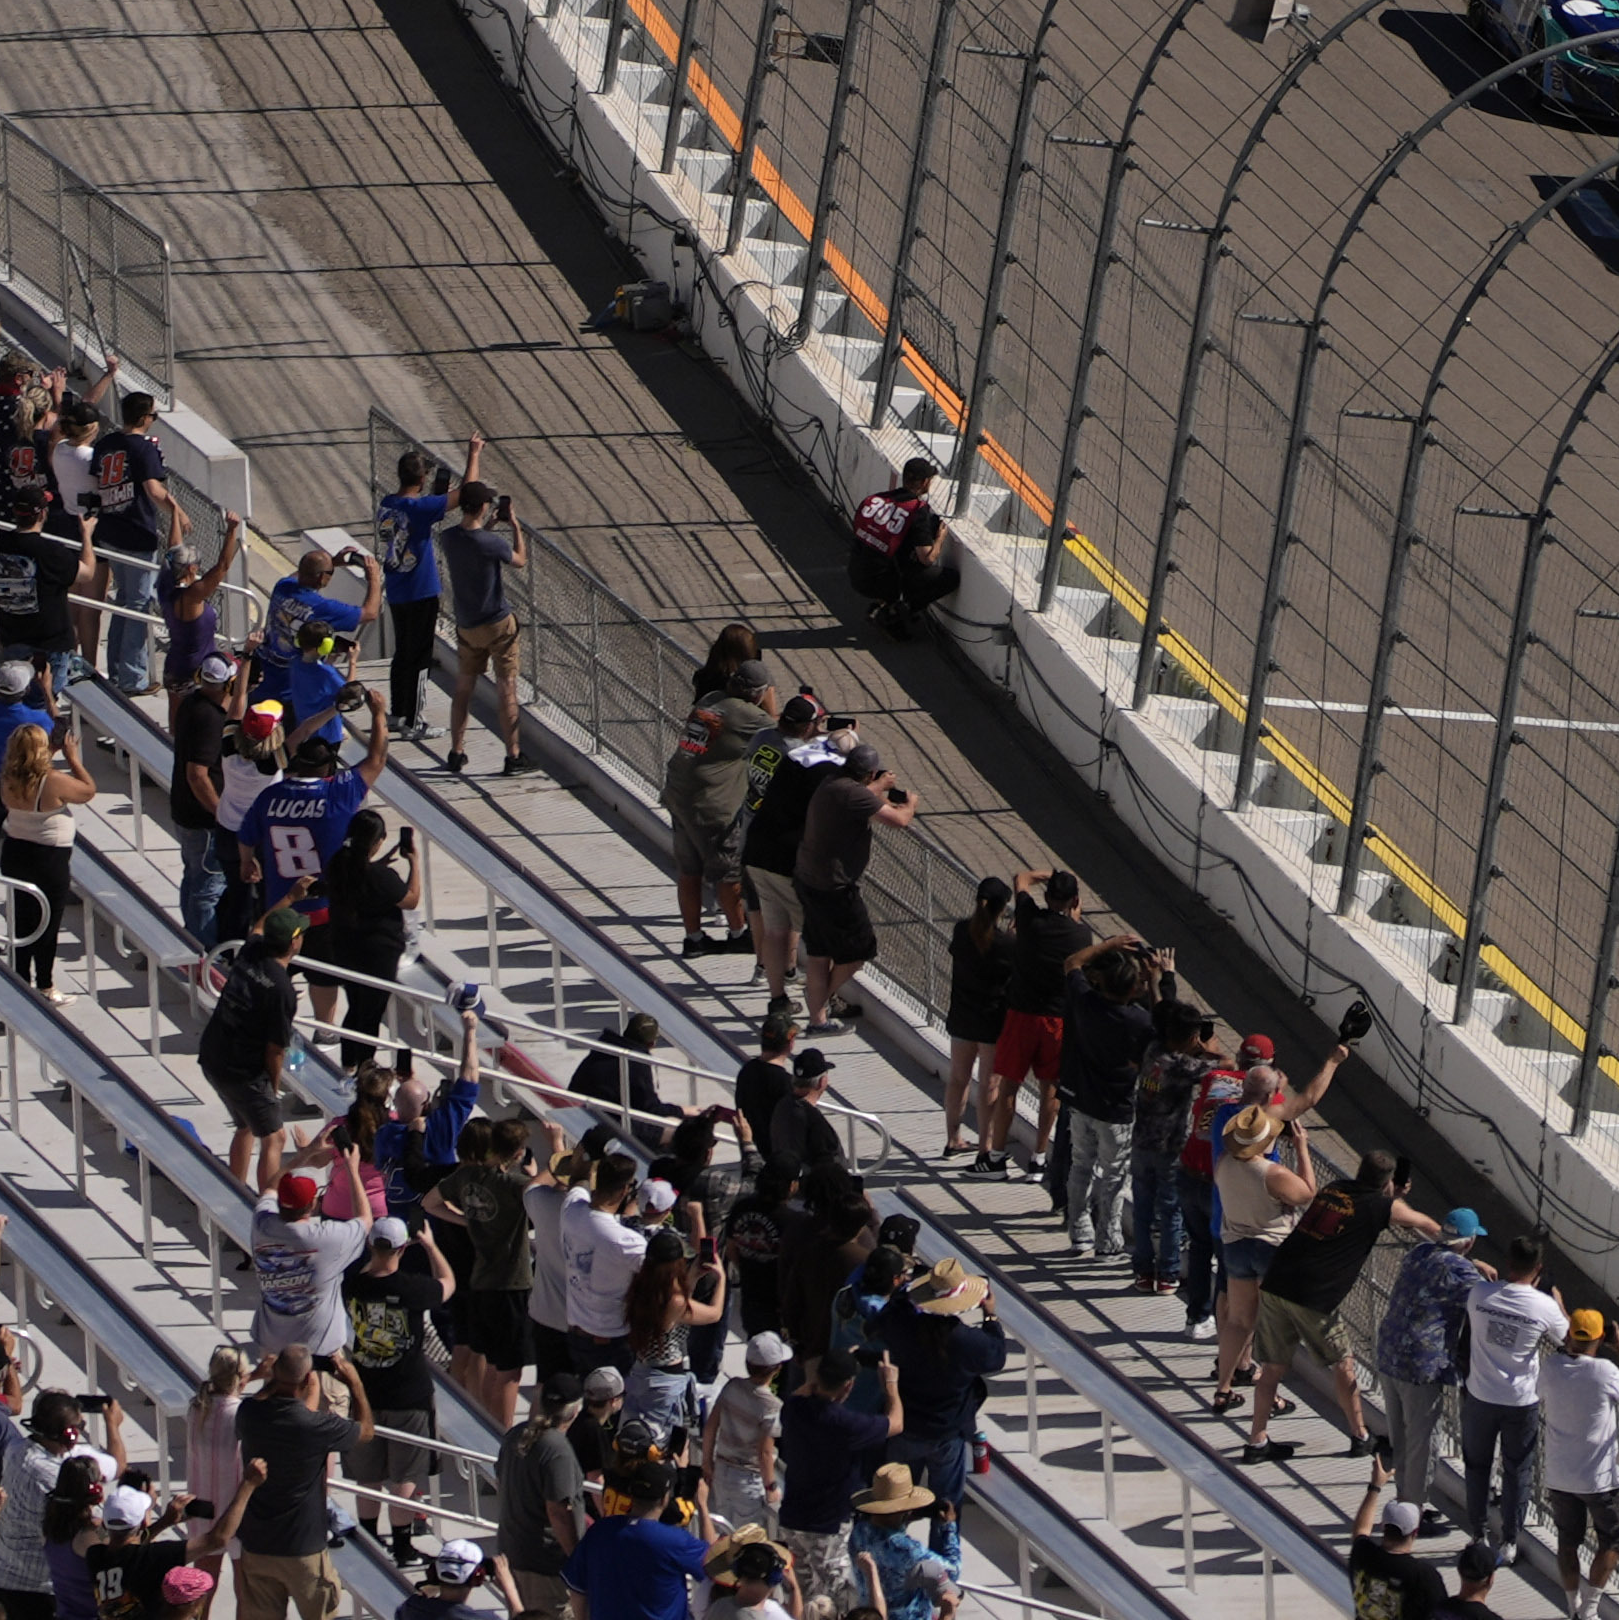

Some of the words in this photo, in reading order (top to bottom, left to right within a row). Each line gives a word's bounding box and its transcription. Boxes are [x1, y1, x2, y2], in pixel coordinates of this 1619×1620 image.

[99, 451, 126, 489] 19
[861, 496, 910, 535] 305
[267, 798, 327, 820] LUCAS
[268, 825, 322, 879] 8
[95, 1566, 124, 1602] 19
